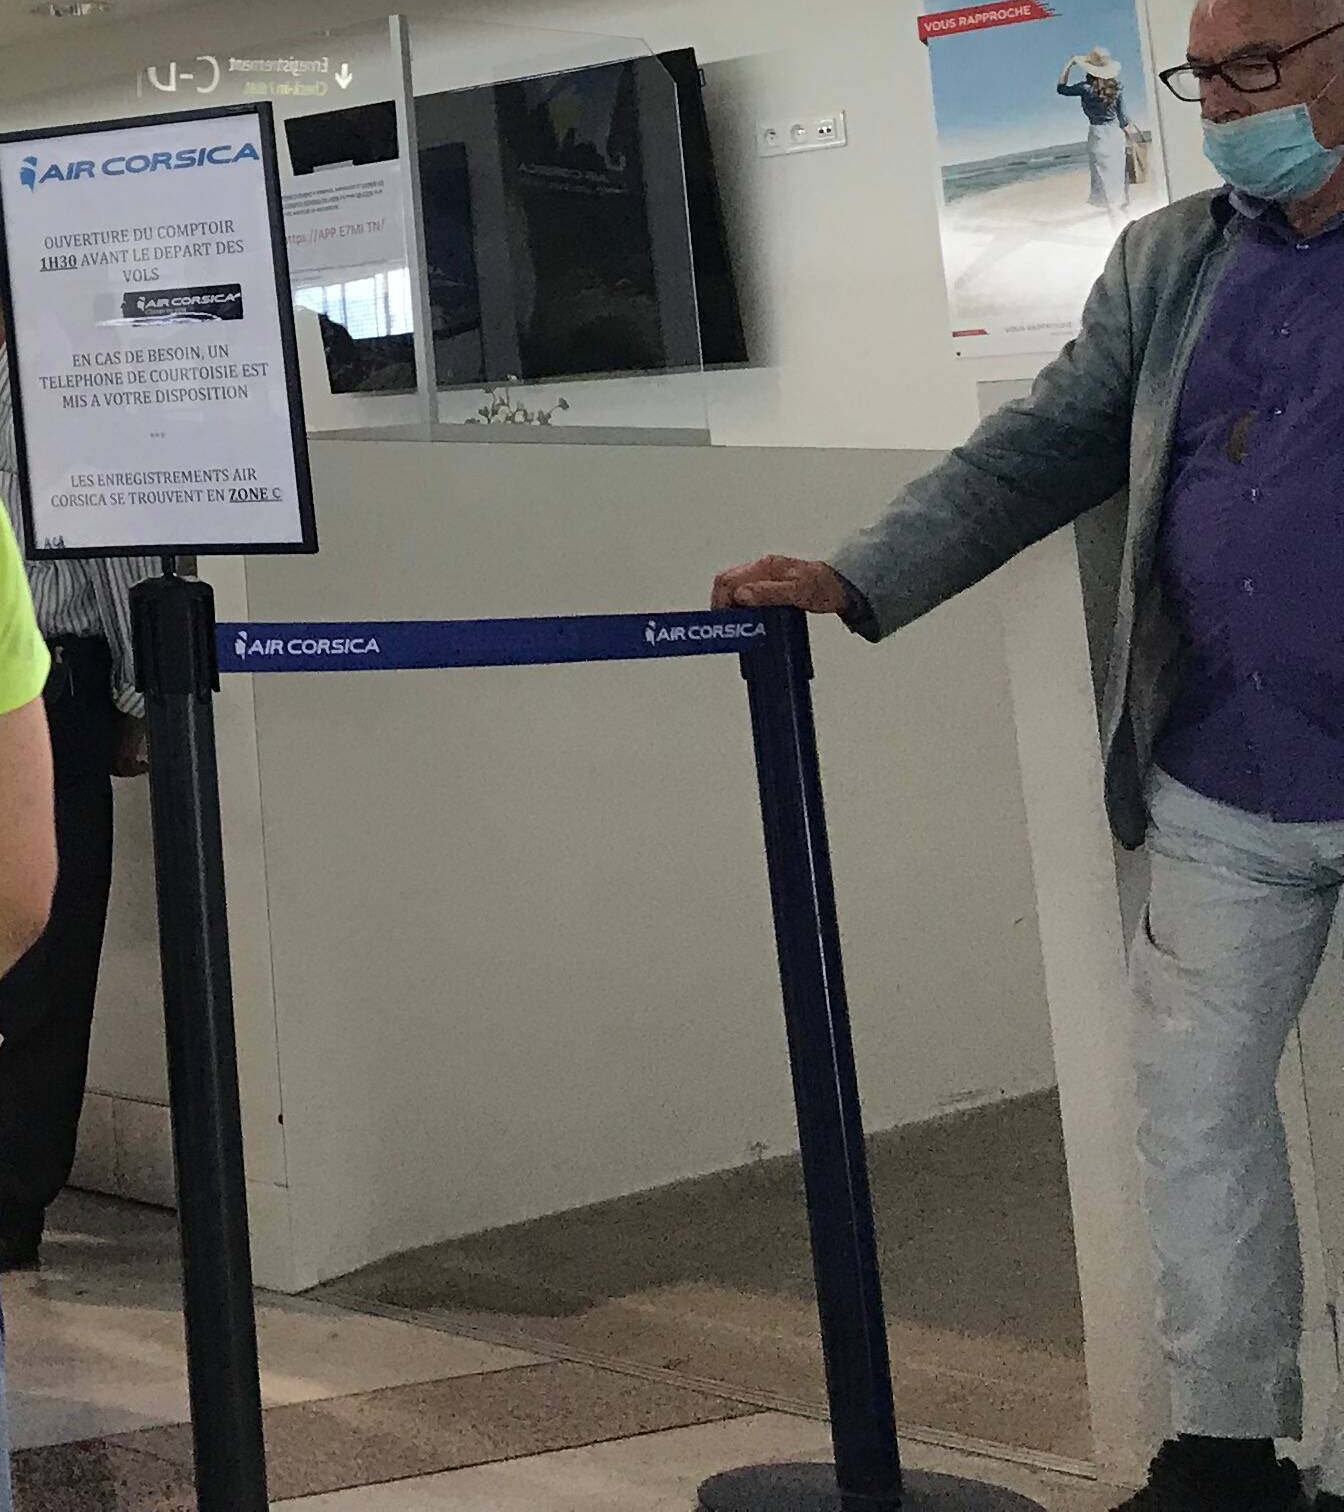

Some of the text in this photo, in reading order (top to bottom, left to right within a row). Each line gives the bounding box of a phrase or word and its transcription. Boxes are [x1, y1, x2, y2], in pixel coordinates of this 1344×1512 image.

[923, 4, 1031, 33] VOUS RAPPROCHE
[38, 143, 260, 184] AIR CORSICA
[44, 219, 235, 250] OUVERTURE DU COMPTOIR
[39, 240, 245, 272] 1H30 AVANT LE DEPART DES
[122, 267, 160, 283] VOLS
[145, 293, 237, 309] AIR CORSICA
[72, 344, 229, 368] EN CAS DE BESOIN, UN
[39, 362, 269, 390] TELEPHONE DE COURTOISIE EST
[62, 385, 249, 409] MIS A VOTRE DISPOSITION
[70, 467, 257, 488] LES ENREGISTREMENTS AIR
[51, 487, 283, 508] CORSICA SE TROUVENT EN ZONE C
[656, 622, 766, 642] AIR CORSICA
[247, 637, 380, 655] AIR CORSICA
